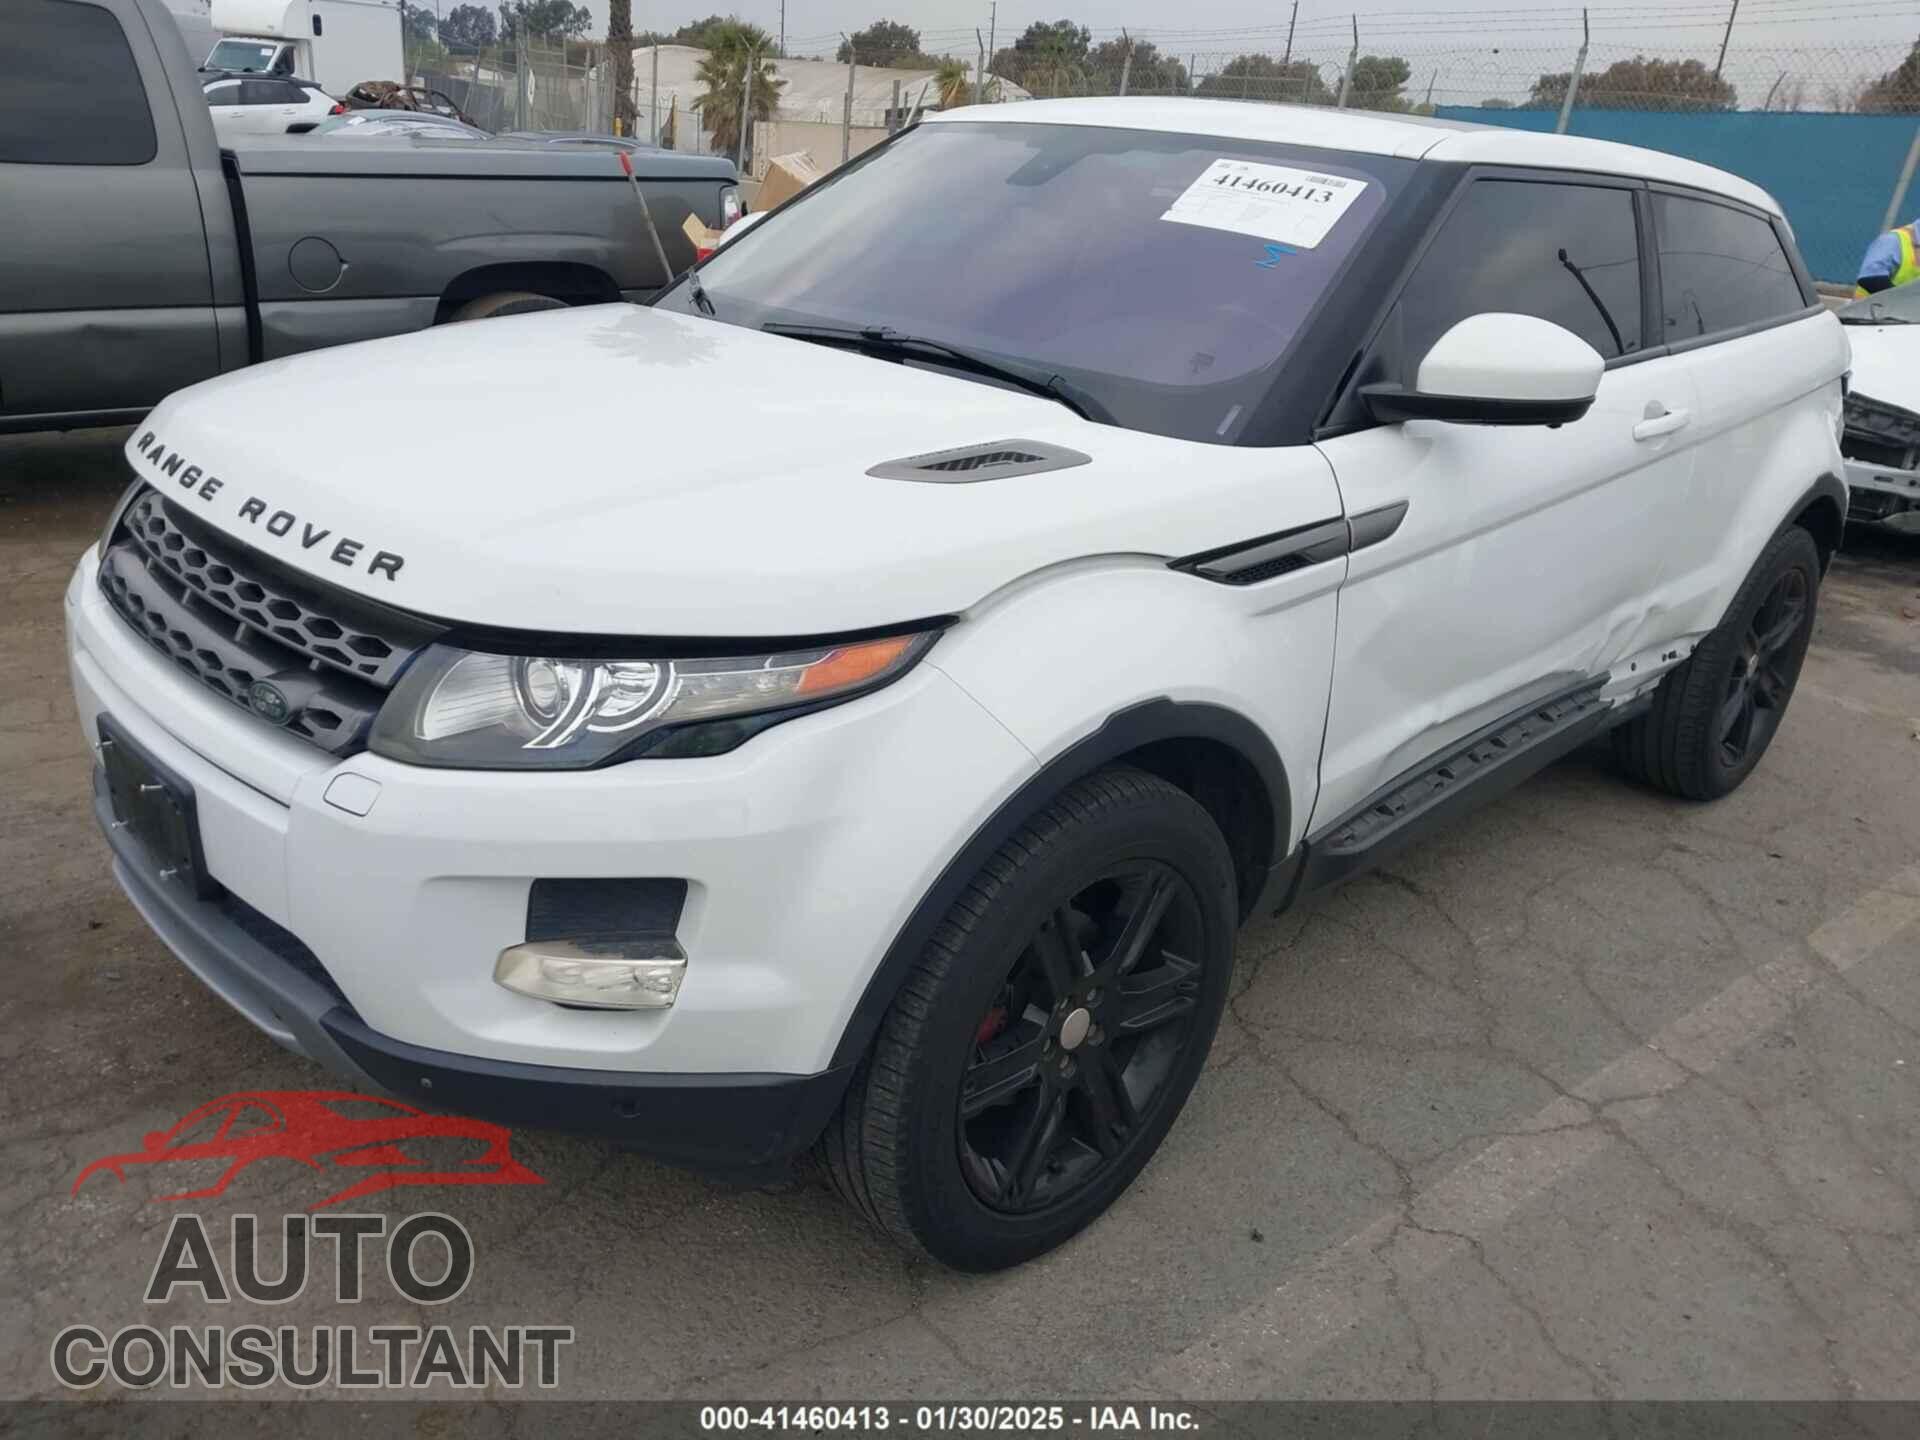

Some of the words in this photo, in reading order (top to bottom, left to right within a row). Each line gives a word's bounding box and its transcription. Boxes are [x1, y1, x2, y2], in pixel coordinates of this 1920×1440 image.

[1214, 174, 1334, 203] 41460413
[137, 431, 224, 501] RANGE
[238, 497, 405, 581] ROVER
